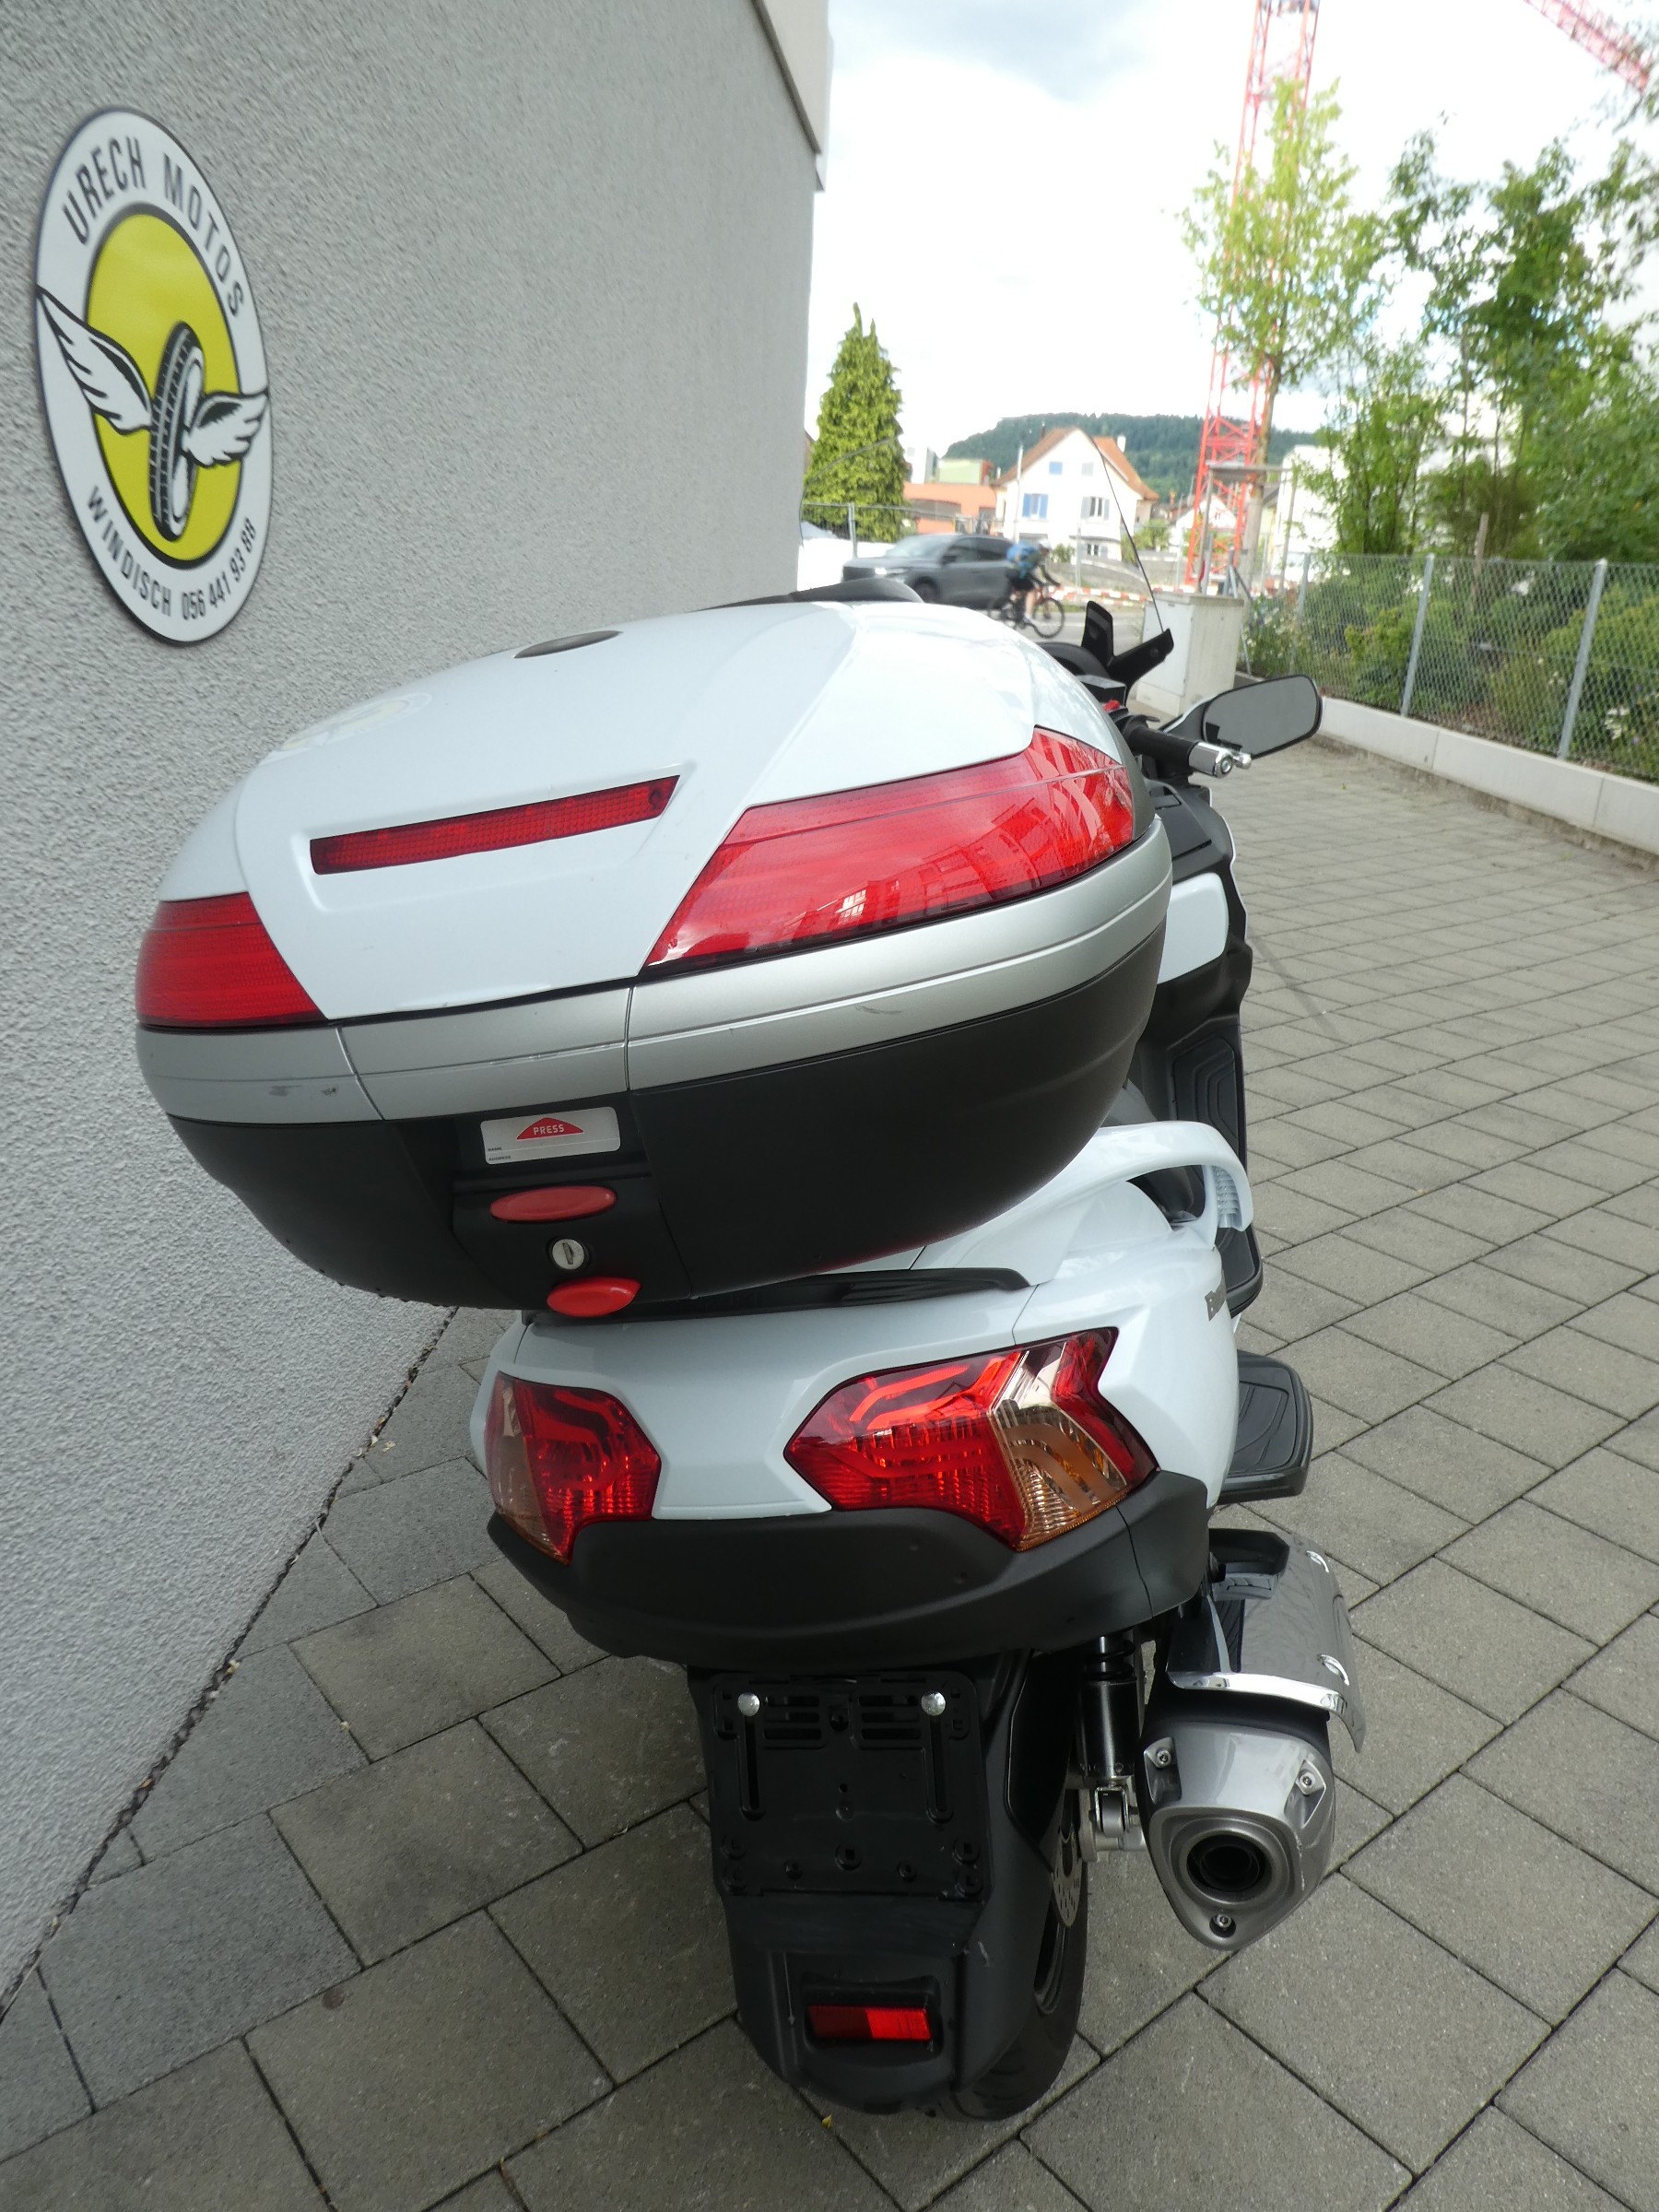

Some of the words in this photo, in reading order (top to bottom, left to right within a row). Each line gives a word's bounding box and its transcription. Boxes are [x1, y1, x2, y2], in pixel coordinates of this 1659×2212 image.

[62, 135, 147, 245] URECH
[163, 152, 244, 317] MOTOS
[88, 485, 172, 618] WINDISCH
[182, 589, 206, 620] 056
[208, 571, 232, 608] 441
[229, 547, 247, 582] 93
[241, 516, 257, 553] 88
[533, 1124, 566, 1135] PRESS
